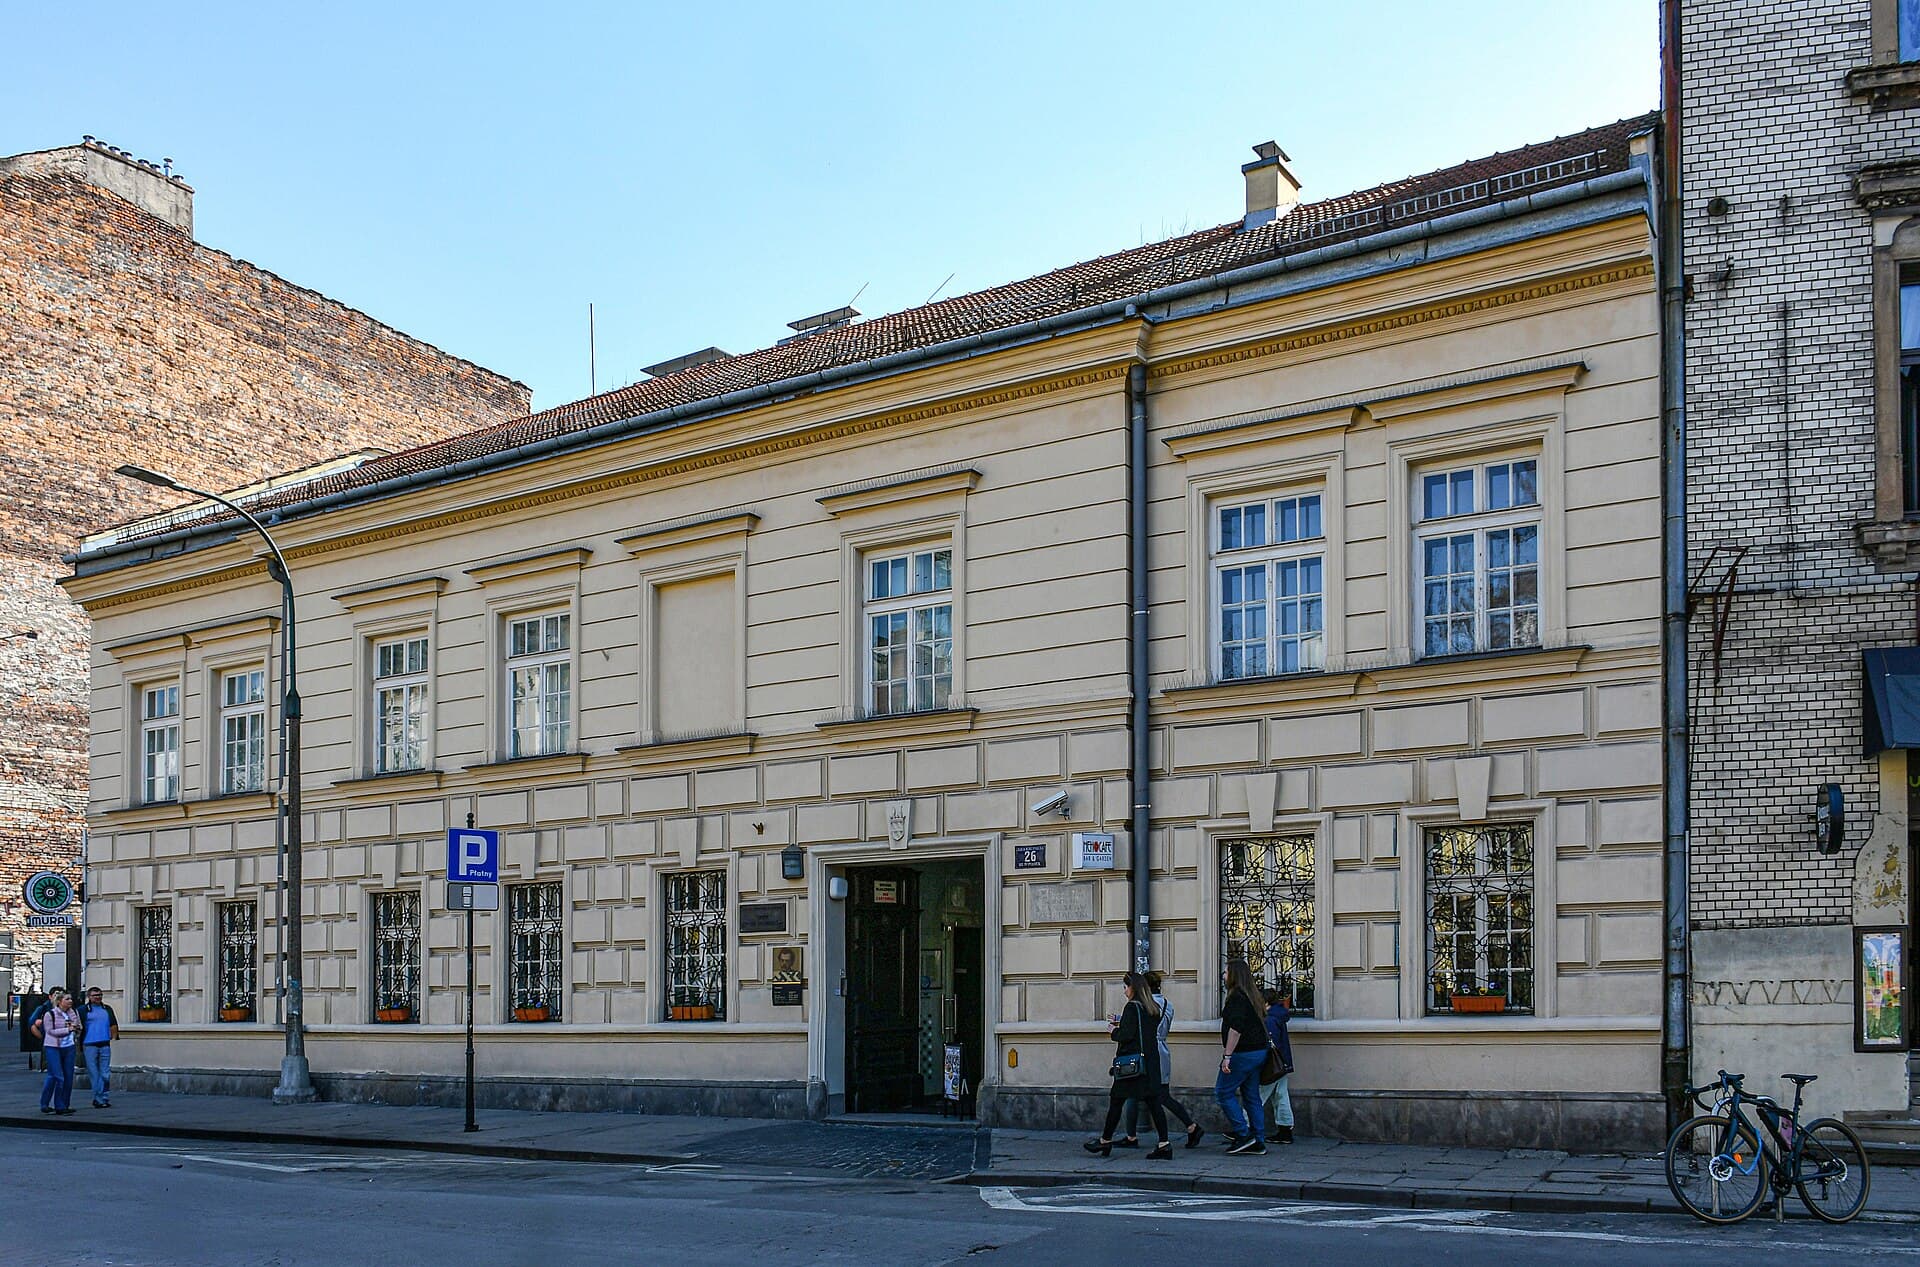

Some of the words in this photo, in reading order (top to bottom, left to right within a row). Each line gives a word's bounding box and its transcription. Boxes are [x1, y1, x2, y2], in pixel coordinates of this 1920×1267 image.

[459, 835, 487, 876] P
[1024, 850, 1037, 862] 26
[31, 916, 72, 925] MURAL
